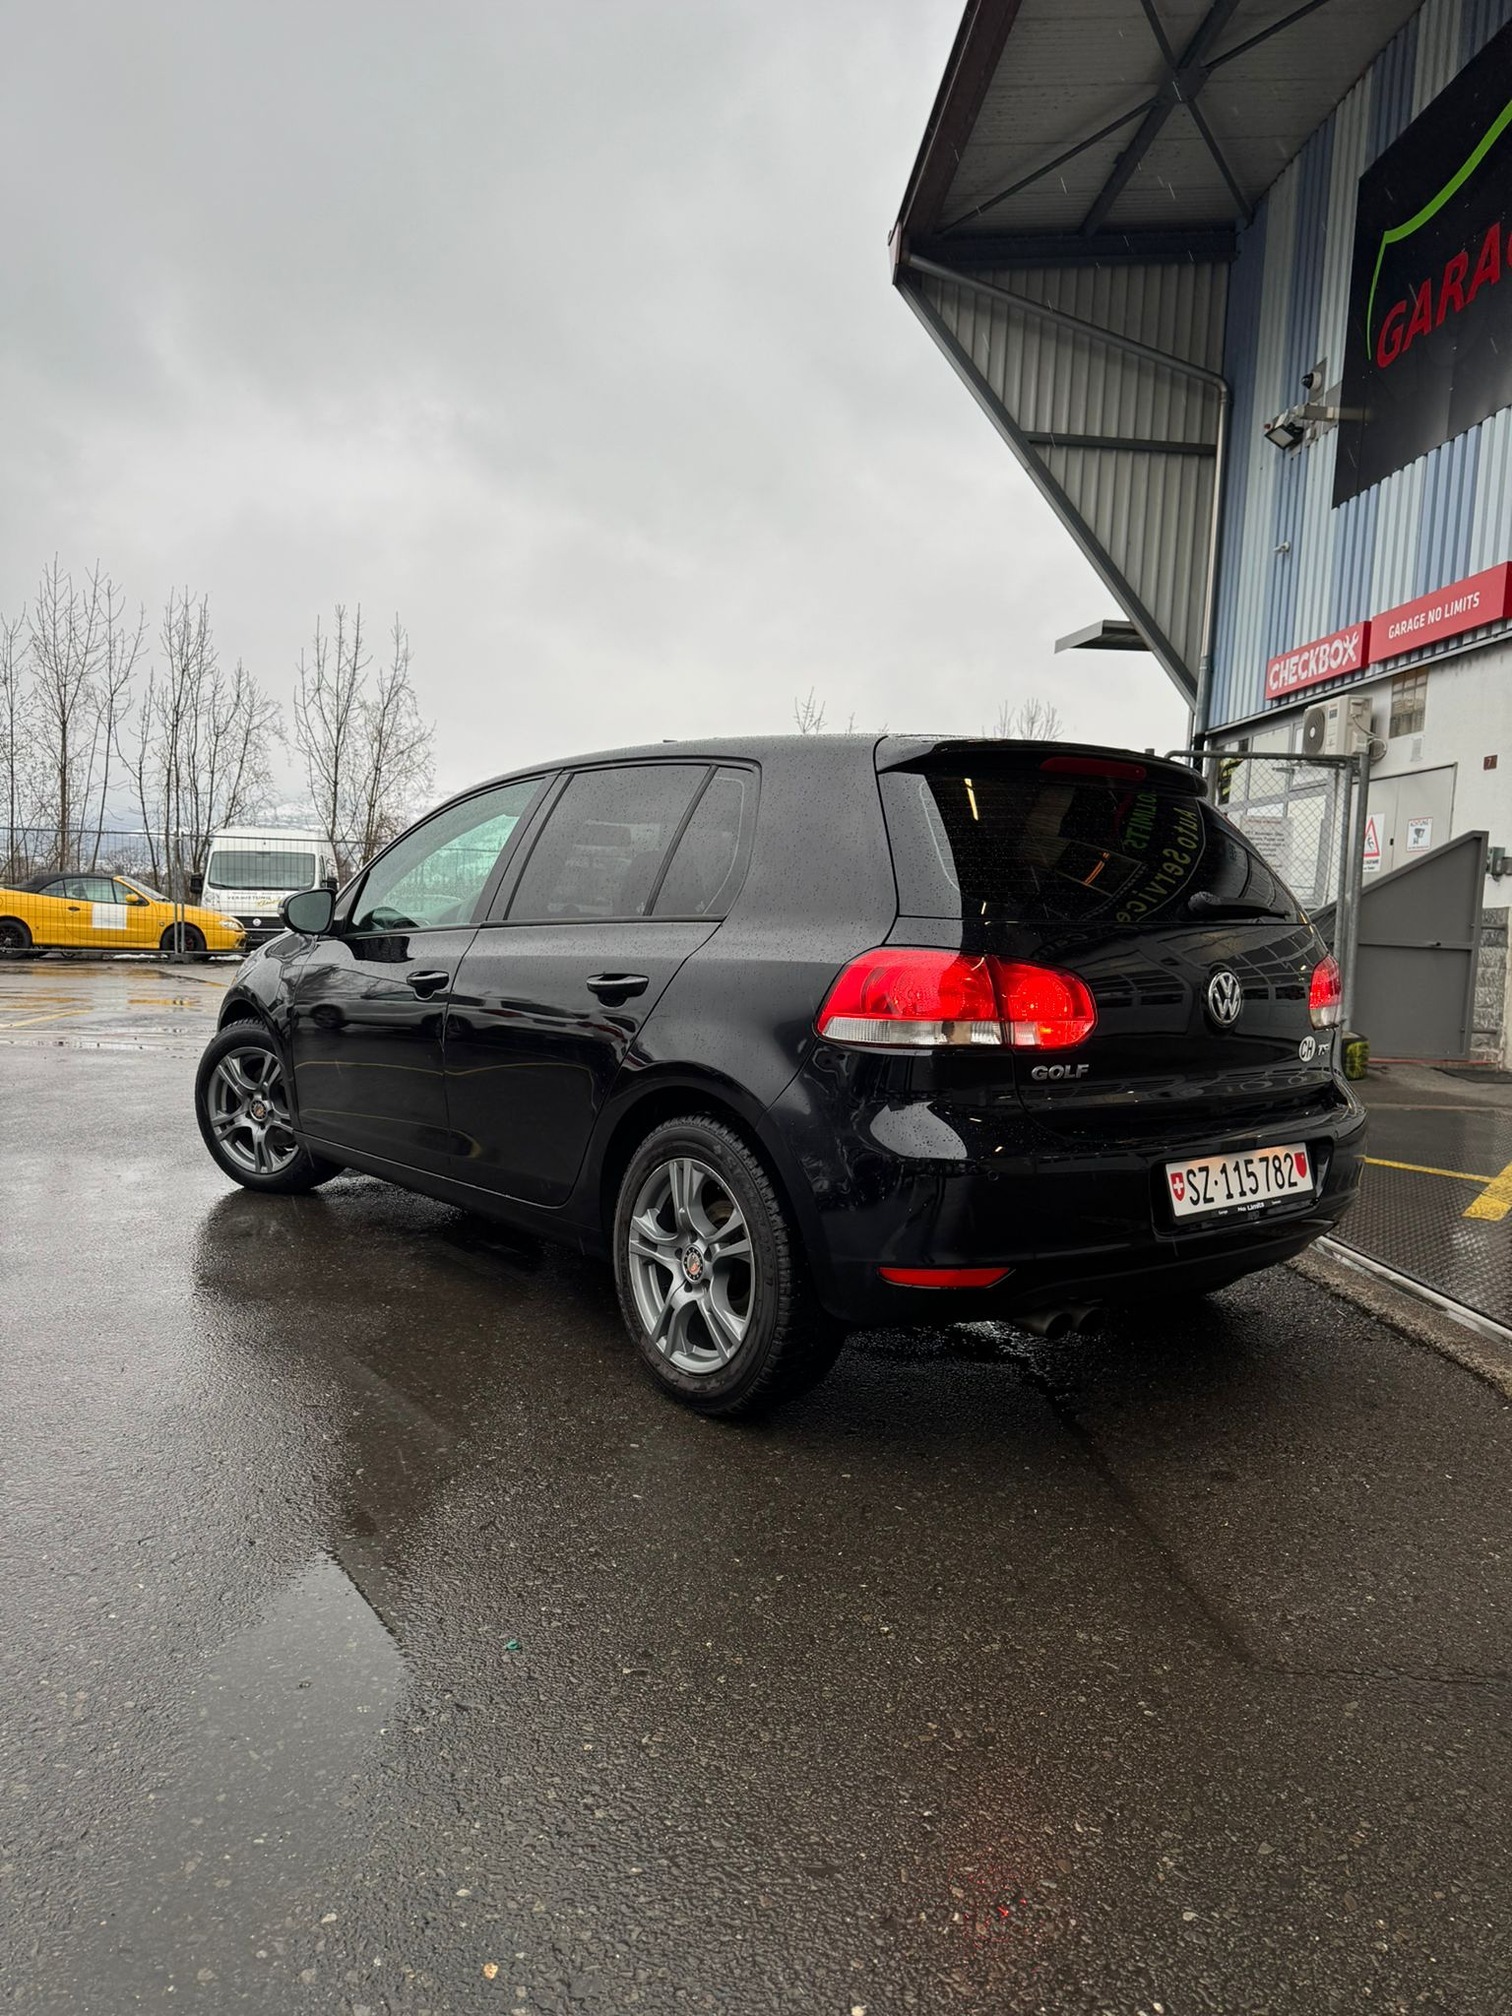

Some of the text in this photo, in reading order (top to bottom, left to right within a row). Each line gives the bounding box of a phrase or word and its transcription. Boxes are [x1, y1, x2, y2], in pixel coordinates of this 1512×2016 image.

[1376, 221, 1512, 369] GARA
[1388, 591, 1481, 639] GARAGE NO LIMITS
[1268, 631, 1359, 691] CHECKBOX
[1031, 1064, 1089, 1080] GOLF
[1301, 1040, 1314, 1058] CH
